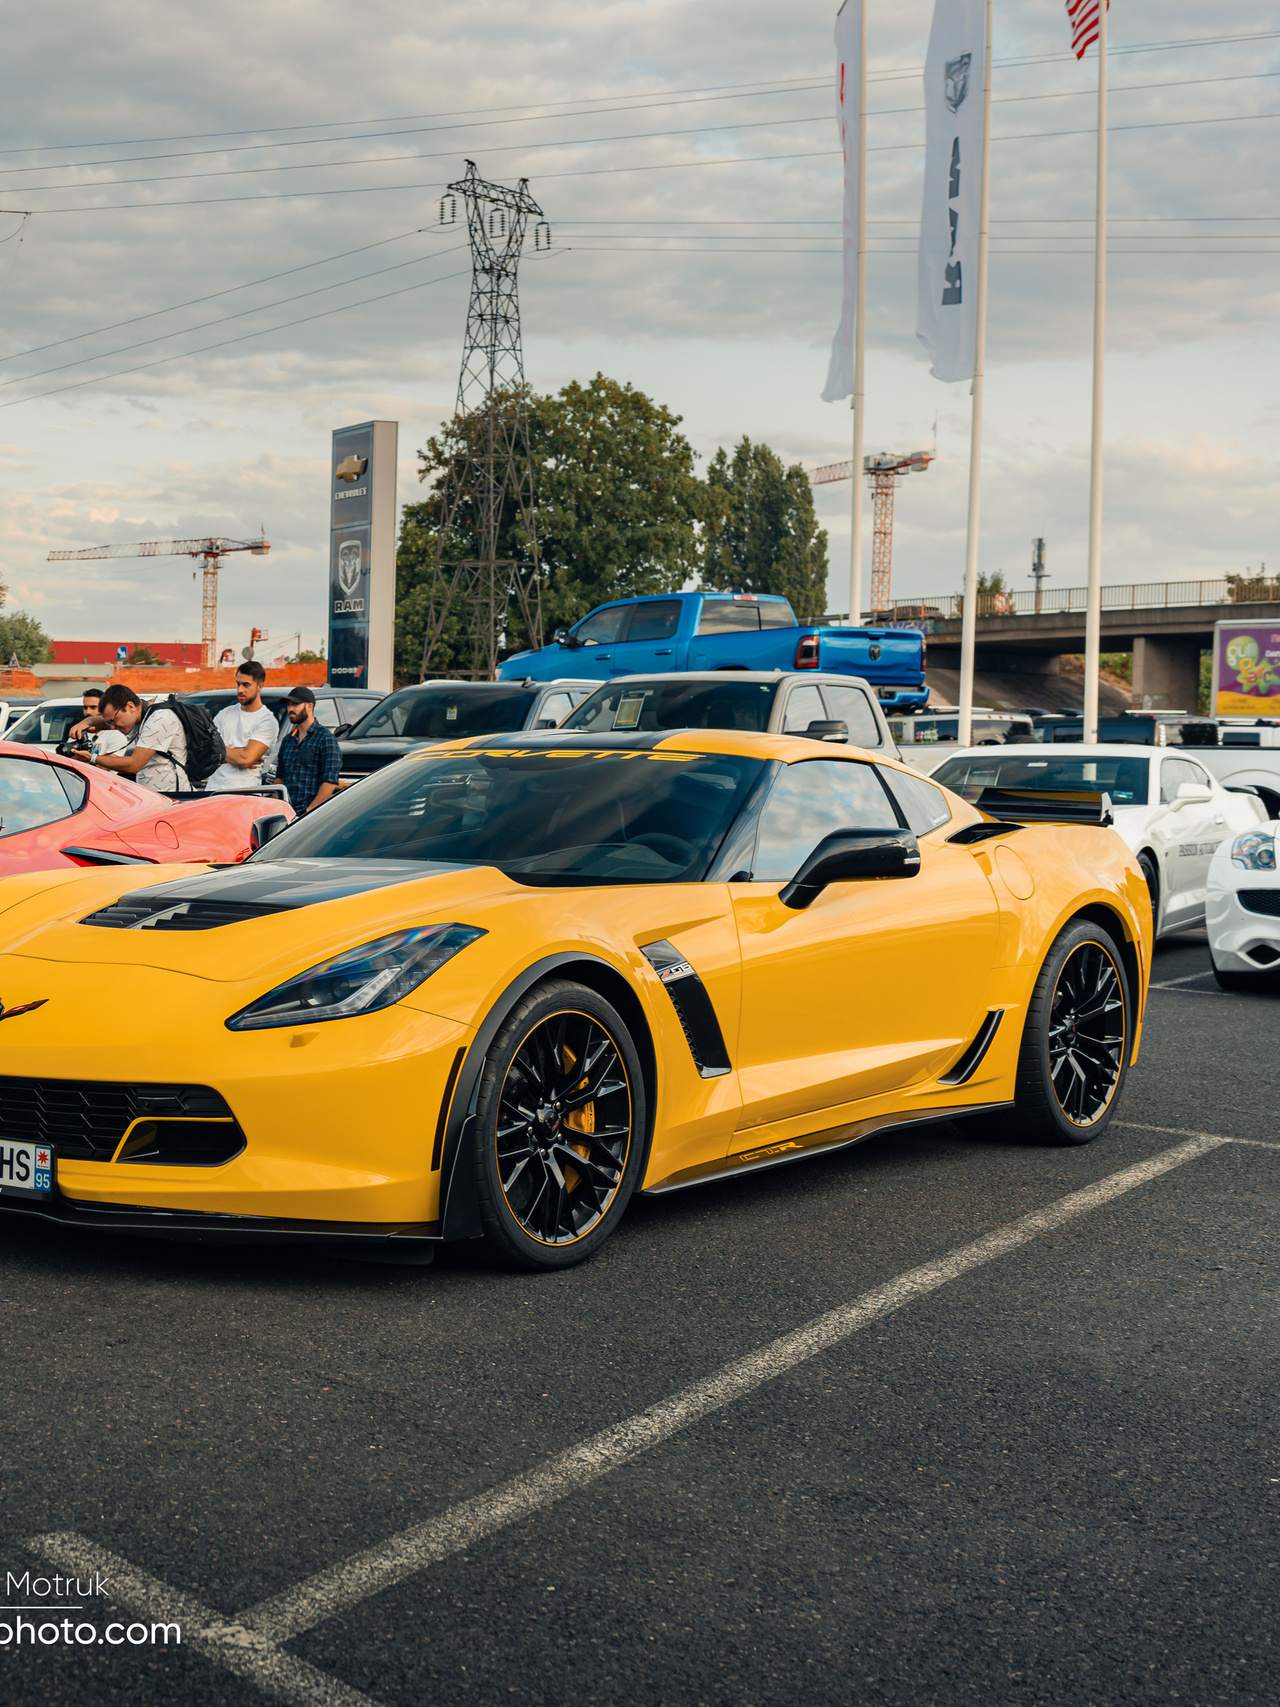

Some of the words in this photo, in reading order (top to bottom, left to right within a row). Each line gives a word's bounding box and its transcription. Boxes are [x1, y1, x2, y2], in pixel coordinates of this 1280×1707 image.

[335, 487, 367, 500] CHEVROLET
[334, 599, 365, 613] RAM
[1240, 658, 1271, 683] Parc
[410, 749, 707, 762] CORVETTE
[35, 1173, 50, 1189] 95
